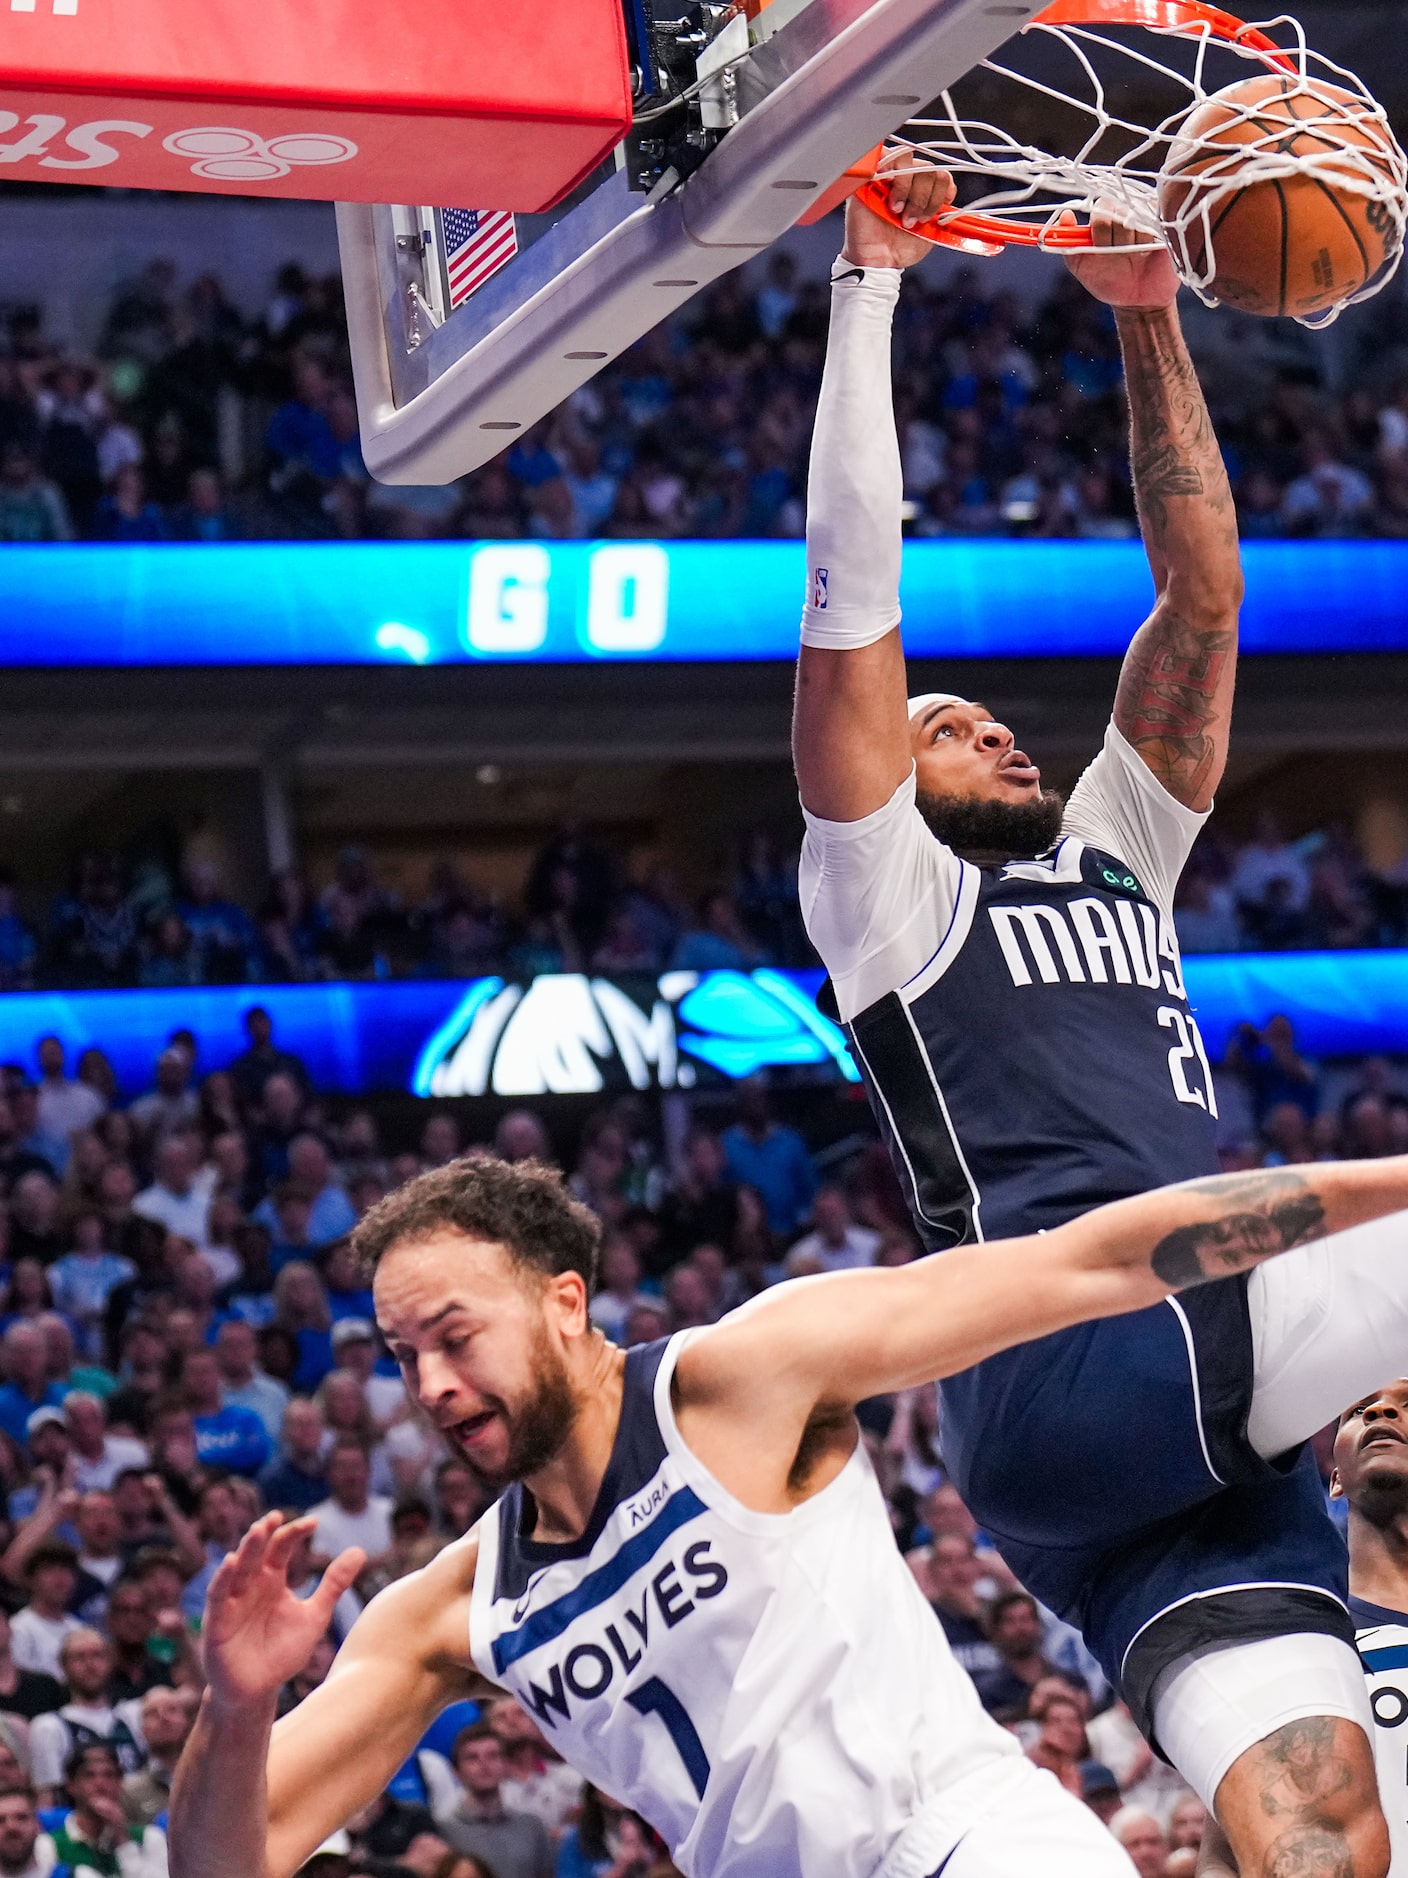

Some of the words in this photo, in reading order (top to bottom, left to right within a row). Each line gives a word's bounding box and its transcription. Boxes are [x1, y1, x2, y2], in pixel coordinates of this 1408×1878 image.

[0, 111, 155, 169] St
[466, 541, 669, 653] GO
[518, 1541, 728, 1730] WOLVES
[624, 1675, 711, 1803] 1
